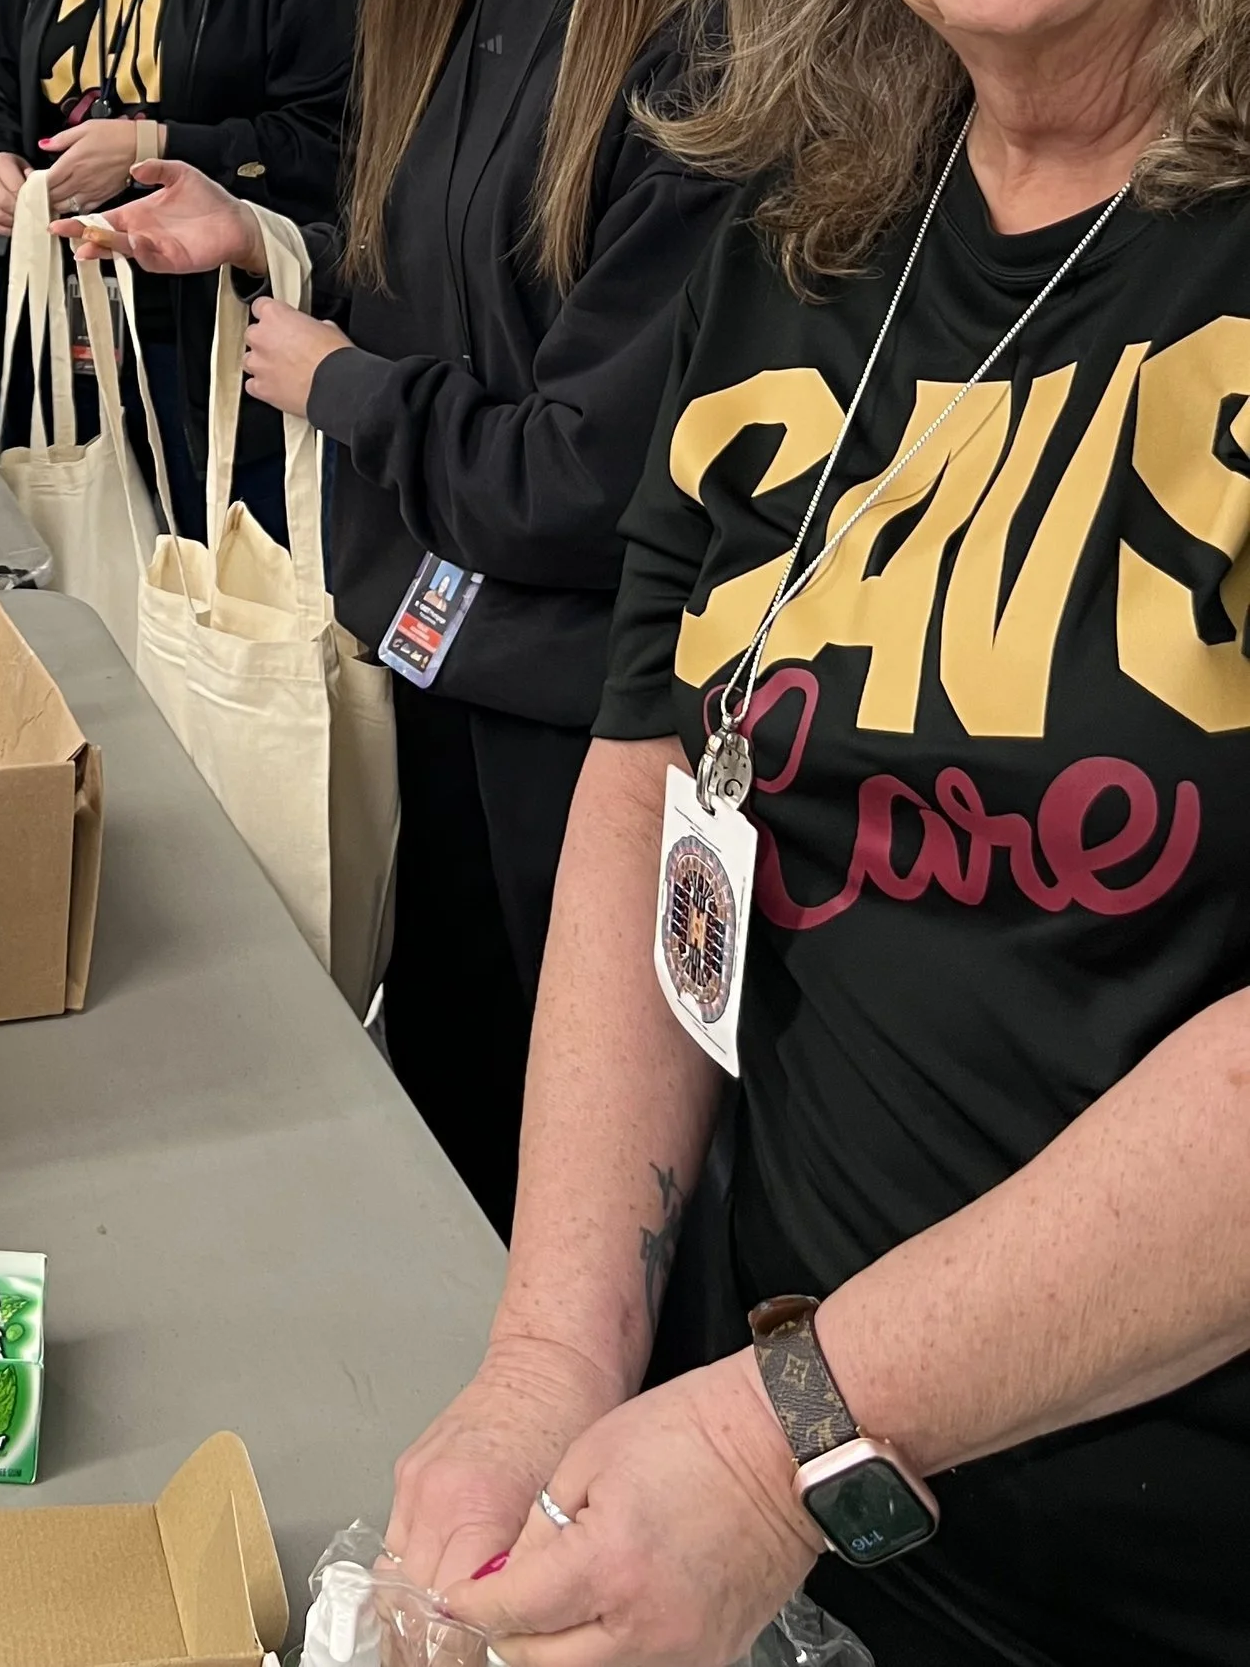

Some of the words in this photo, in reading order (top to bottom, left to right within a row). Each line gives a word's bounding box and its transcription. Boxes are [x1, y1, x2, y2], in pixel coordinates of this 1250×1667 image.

[669, 315, 1250, 738] CAVS
[704, 667, 1201, 930] Care
[852, 1529, 883, 1551] 1:16
